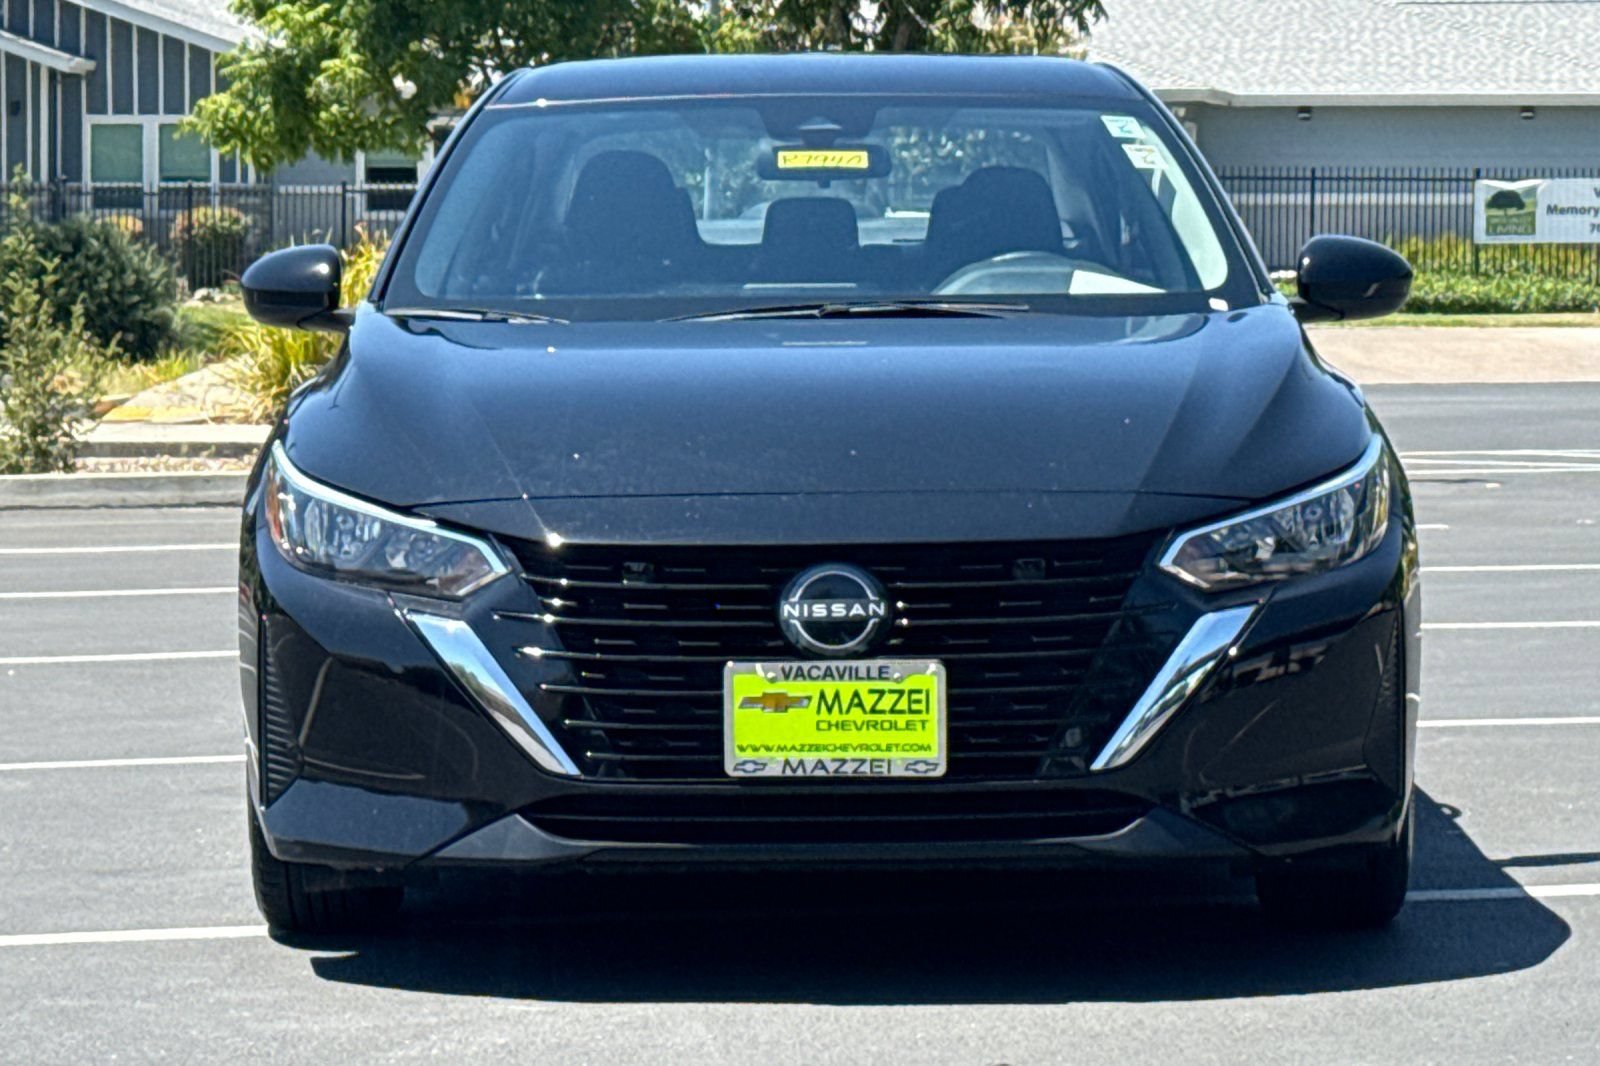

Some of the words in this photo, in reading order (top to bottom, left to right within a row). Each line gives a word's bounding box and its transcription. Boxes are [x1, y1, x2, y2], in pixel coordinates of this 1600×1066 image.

[1546, 205, 1600, 218] Memory
[783, 602, 885, 618] NISSAN
[781, 665, 891, 681] VACAVILLE
[815, 688, 930, 716] MAZZEI
[815, 719, 930, 732] CHEVROLET
[781, 758, 892, 775] MAZZEI
